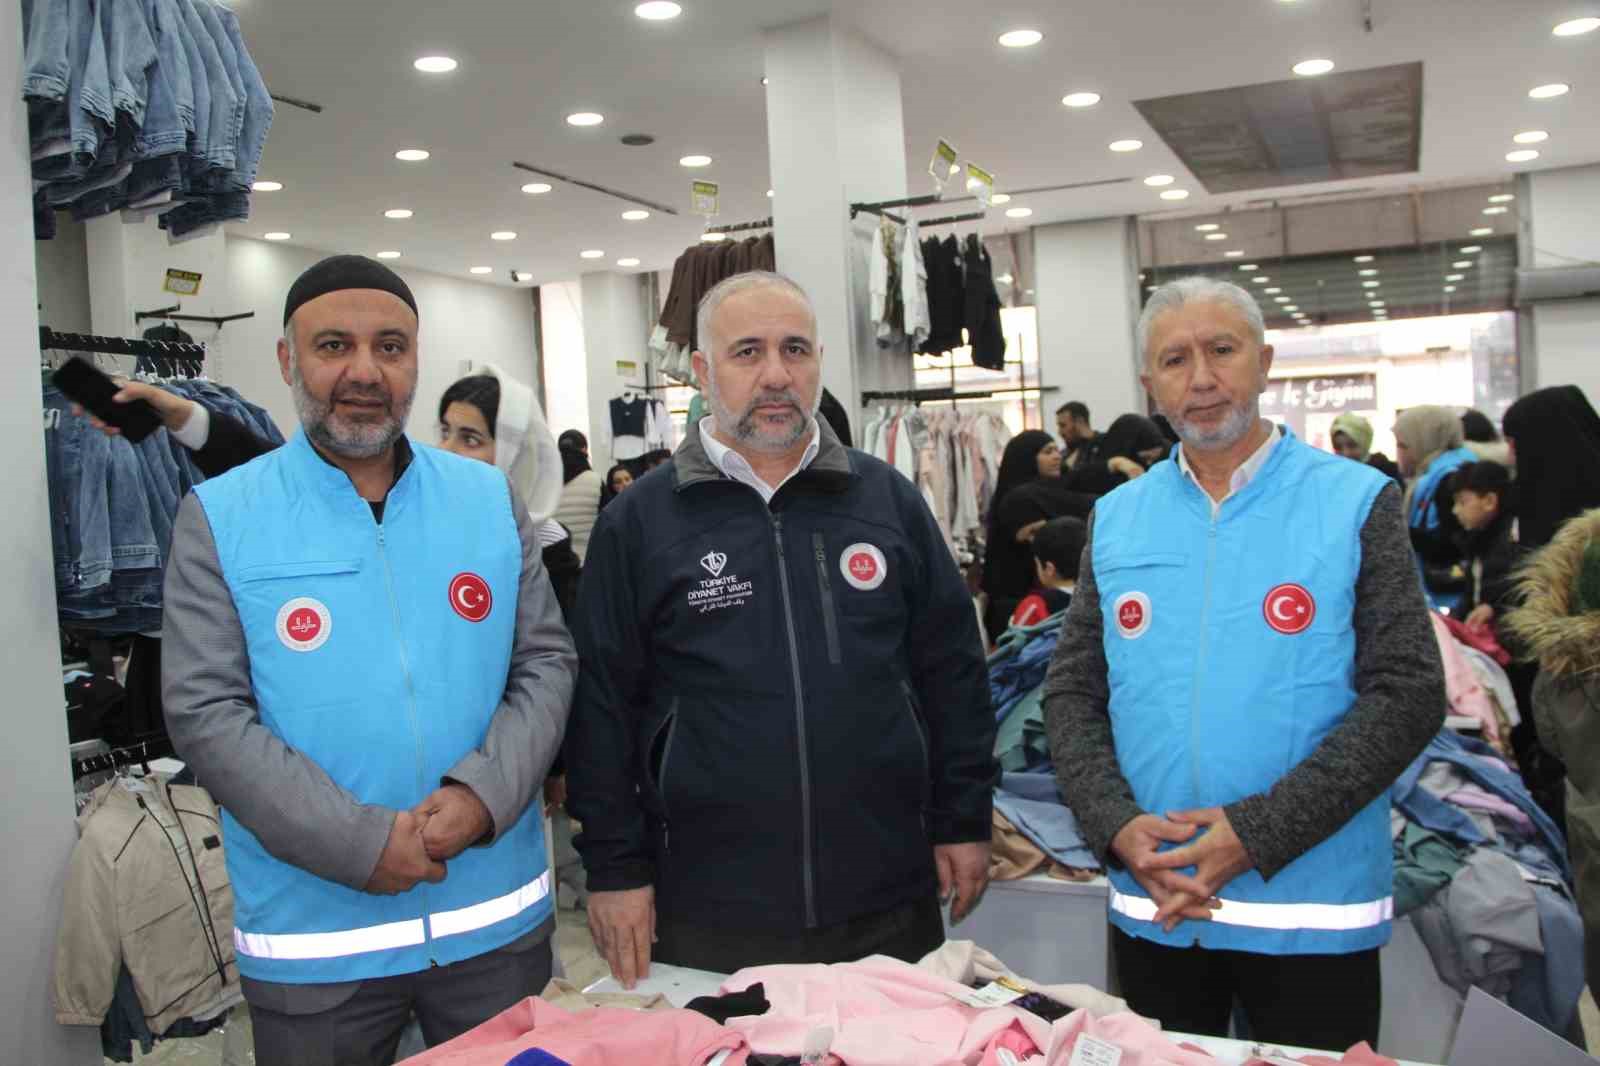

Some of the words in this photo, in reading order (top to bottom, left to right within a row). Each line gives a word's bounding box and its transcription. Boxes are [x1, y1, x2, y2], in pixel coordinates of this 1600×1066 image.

[699, 574, 737, 589] TÜRKİYE
[687, 586, 725, 600] DİYANET
[726, 581, 752, 593] VAKFI
